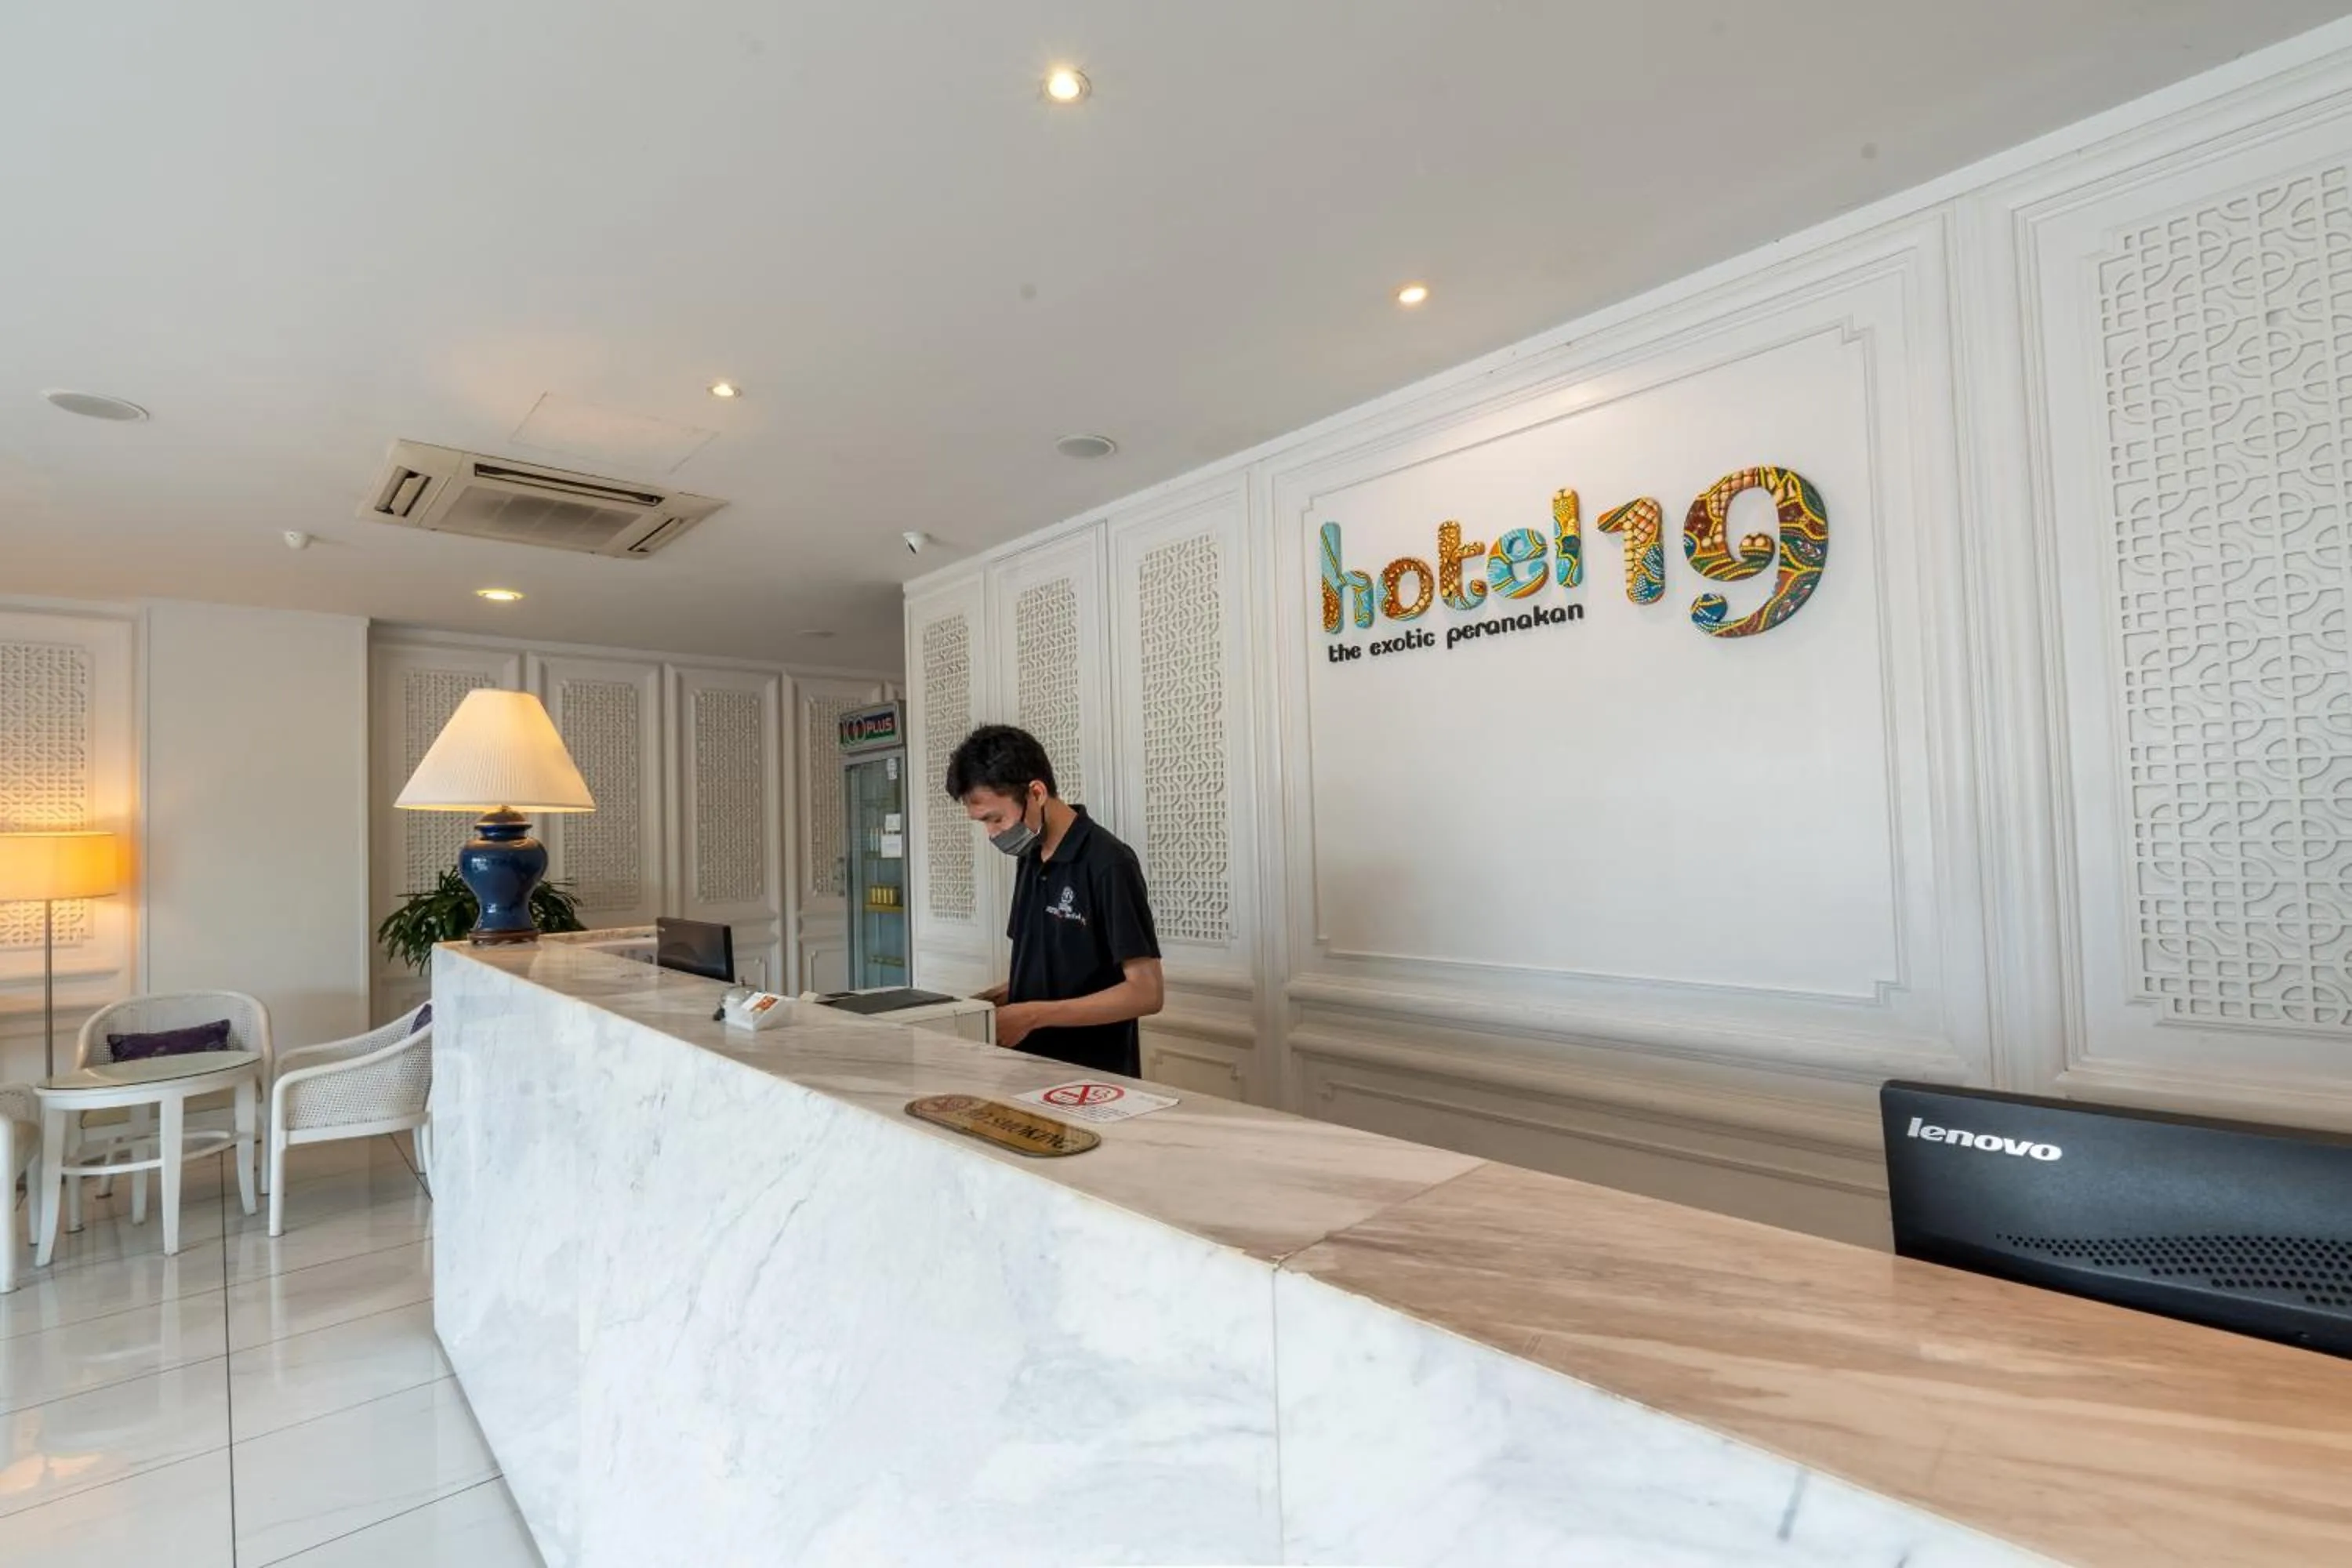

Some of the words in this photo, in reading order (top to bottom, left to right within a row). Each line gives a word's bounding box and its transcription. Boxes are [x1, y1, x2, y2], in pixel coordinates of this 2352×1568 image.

[1319, 488, 1584, 634] hotel
[1596, 464, 1828, 637] 19
[1328, 644, 1362, 662] the
[1369, 628, 1436, 656] exotic
[1446, 603, 1584, 650] peranakan
[1907, 1117, 2063, 1161] lenovo
